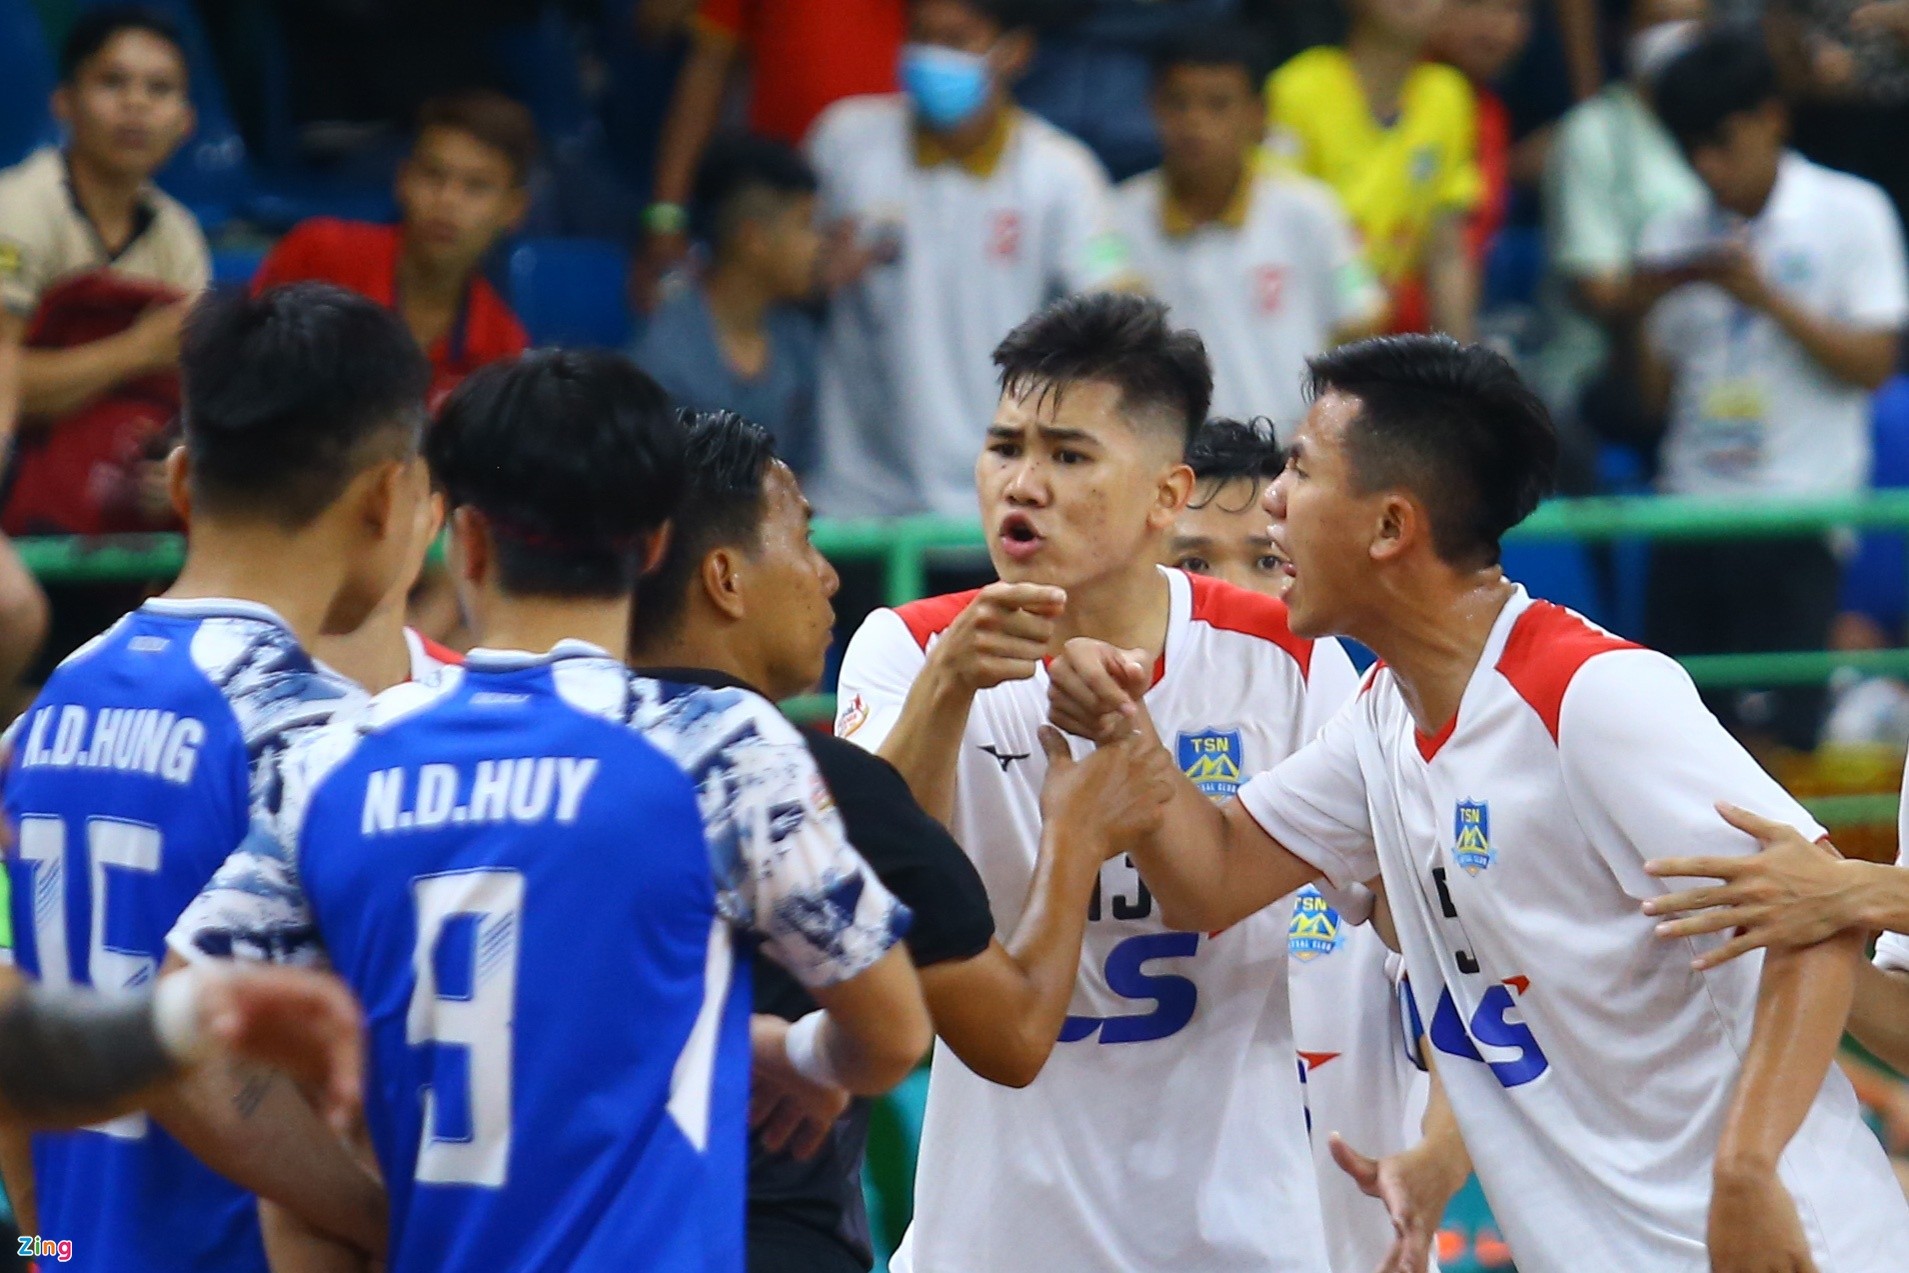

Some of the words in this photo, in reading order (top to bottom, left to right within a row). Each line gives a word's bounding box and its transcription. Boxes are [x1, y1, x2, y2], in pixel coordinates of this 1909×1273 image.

[1190, 737, 1229, 753] TSN
[361, 756, 599, 836] N.D.HUY
[1460, 808, 1480, 823] TSN
[1294, 896, 1328, 911] TSN
[405, 867, 526, 1188] 9
